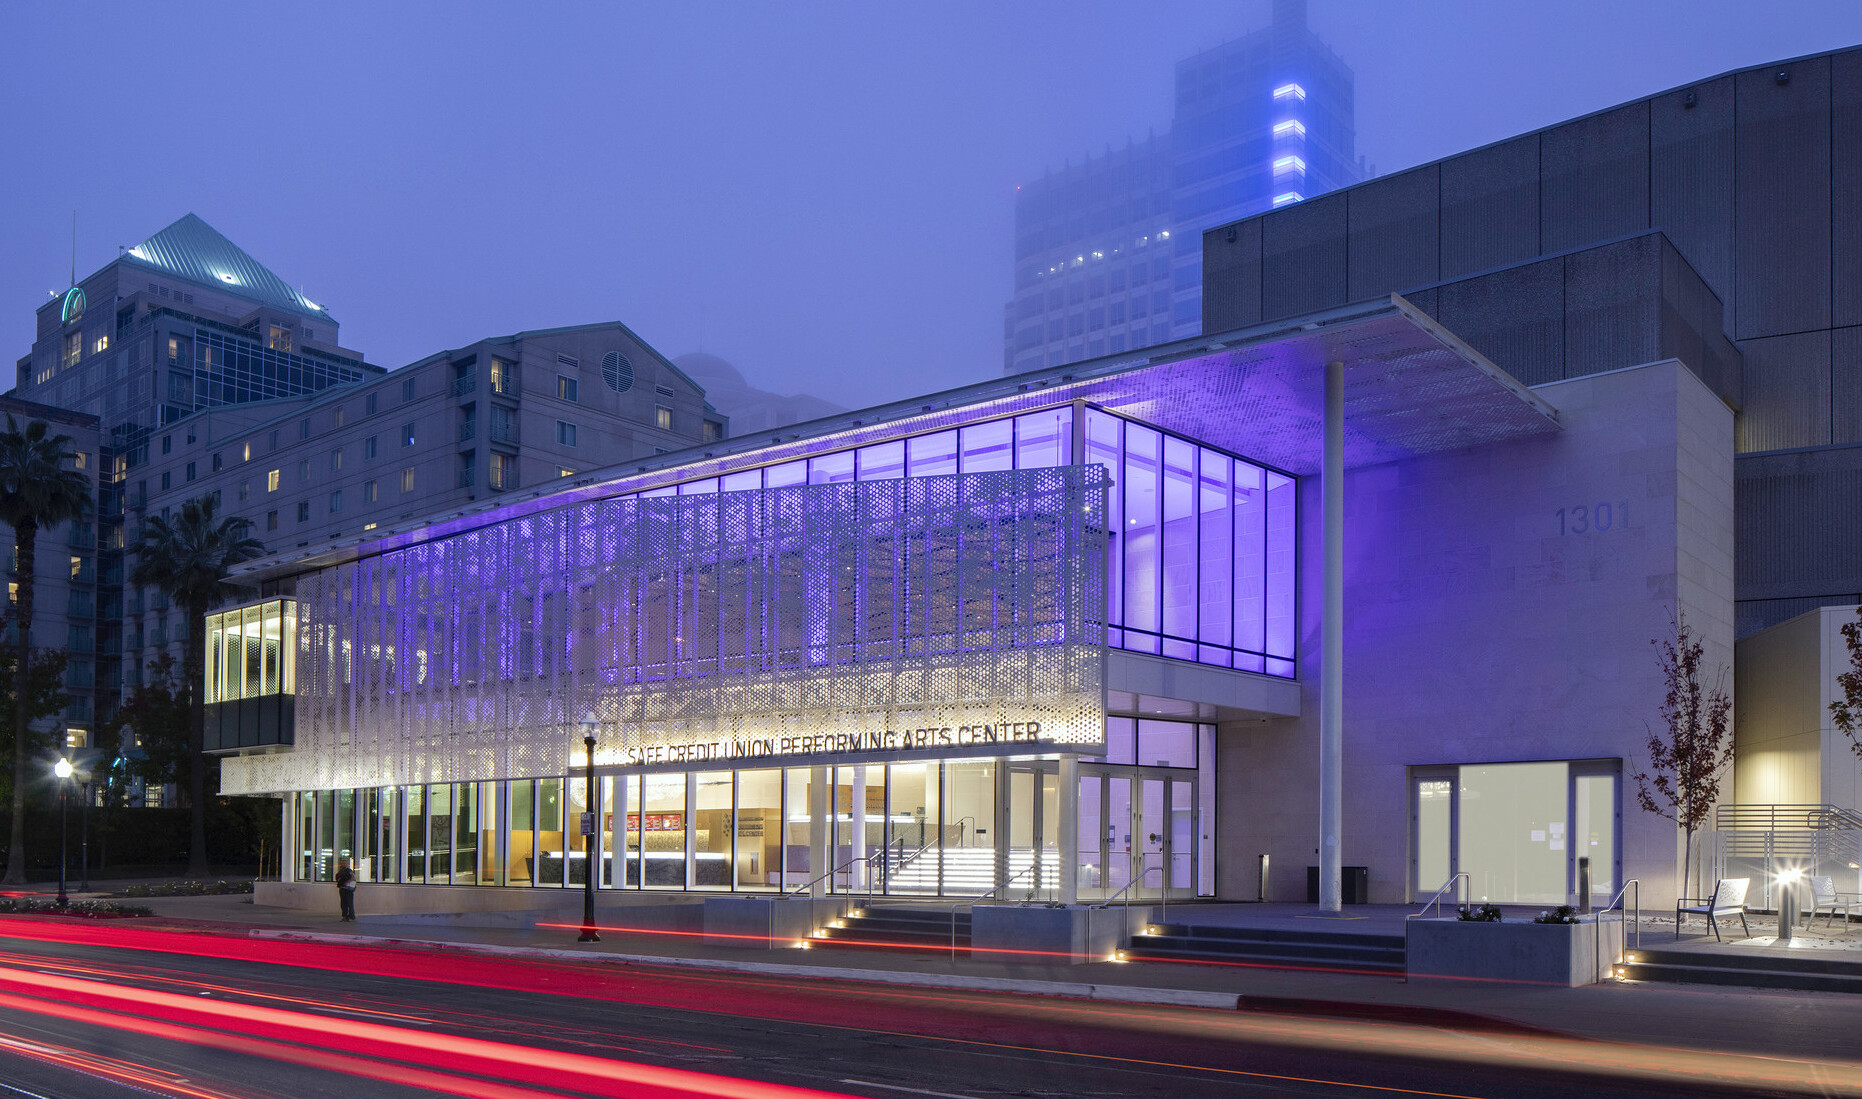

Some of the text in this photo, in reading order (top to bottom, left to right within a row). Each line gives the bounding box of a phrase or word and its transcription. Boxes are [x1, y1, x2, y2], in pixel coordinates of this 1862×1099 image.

[1555, 499, 1629, 536] 1301
[627, 721, 1042, 765] SAFE CREDIT UNION PERFORMING ARTS CENTER
